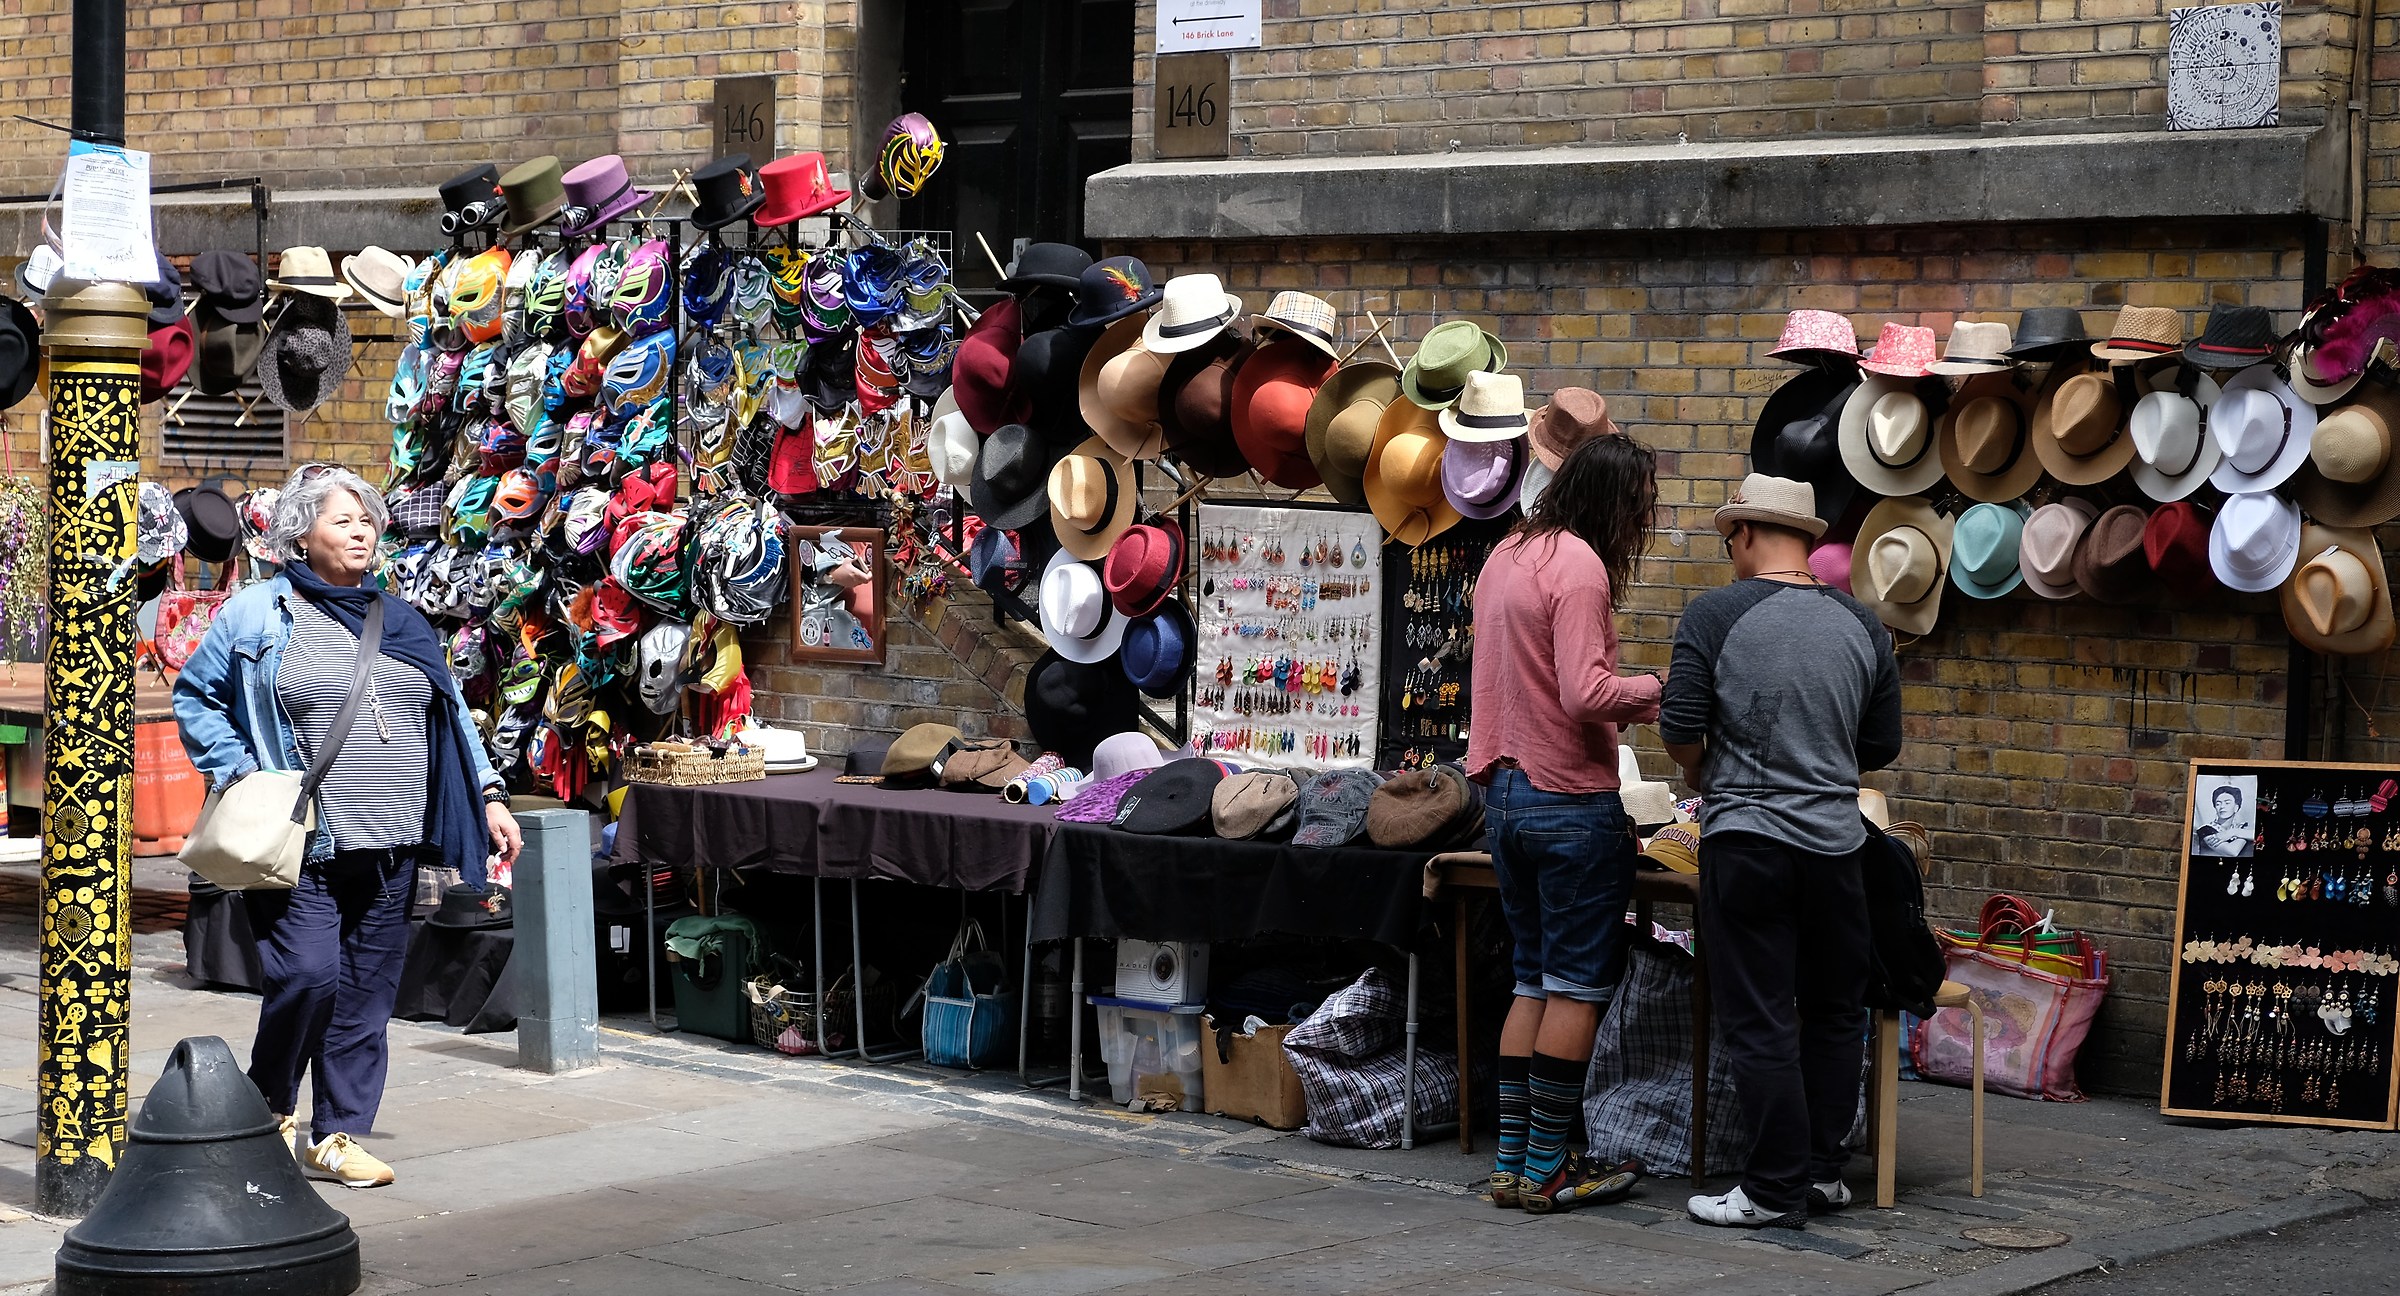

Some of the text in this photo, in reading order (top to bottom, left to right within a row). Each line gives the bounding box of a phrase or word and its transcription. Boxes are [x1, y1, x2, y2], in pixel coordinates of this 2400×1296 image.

[1182, 30, 1234, 40] 146 Brick Lane
[1166, 82, 1216, 128] 146
[722, 102, 764, 144] 146
[1655, 827, 1700, 855] ONDON
